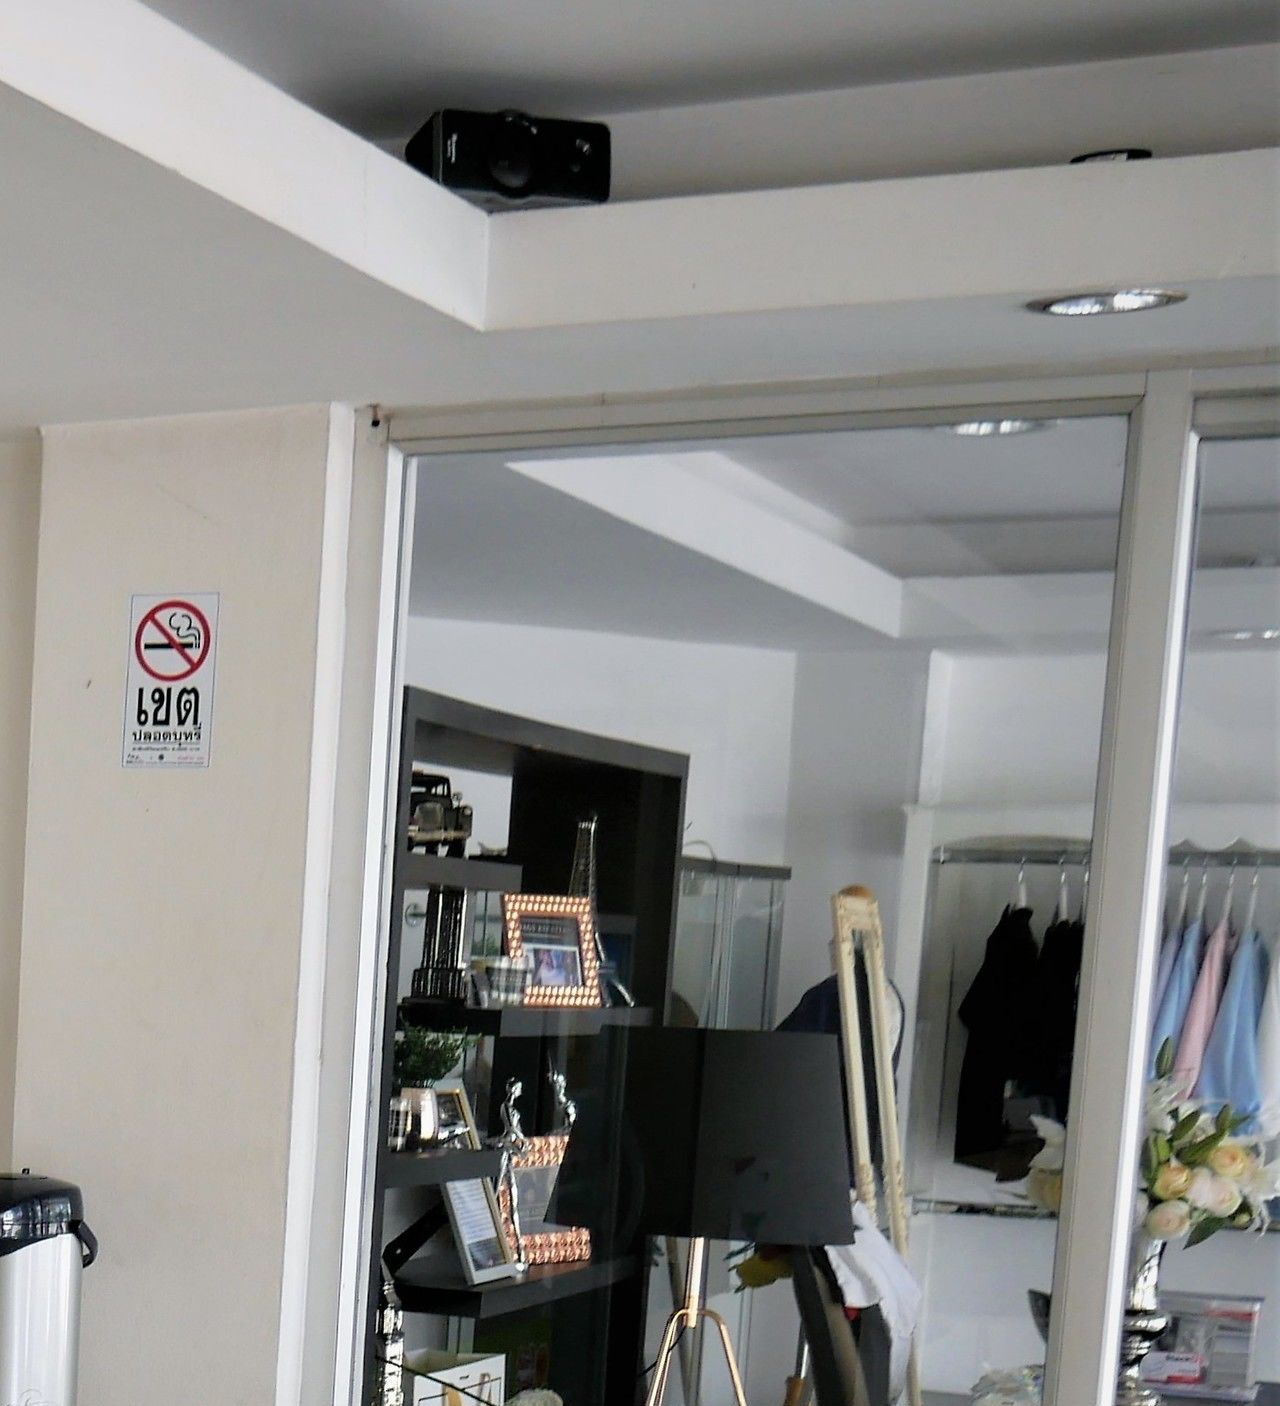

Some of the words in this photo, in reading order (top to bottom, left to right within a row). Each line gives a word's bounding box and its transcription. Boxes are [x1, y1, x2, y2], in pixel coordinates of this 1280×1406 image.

[136, 686, 200, 727] เขต
[132, 722, 203, 747] ปลอดบุหรี่
